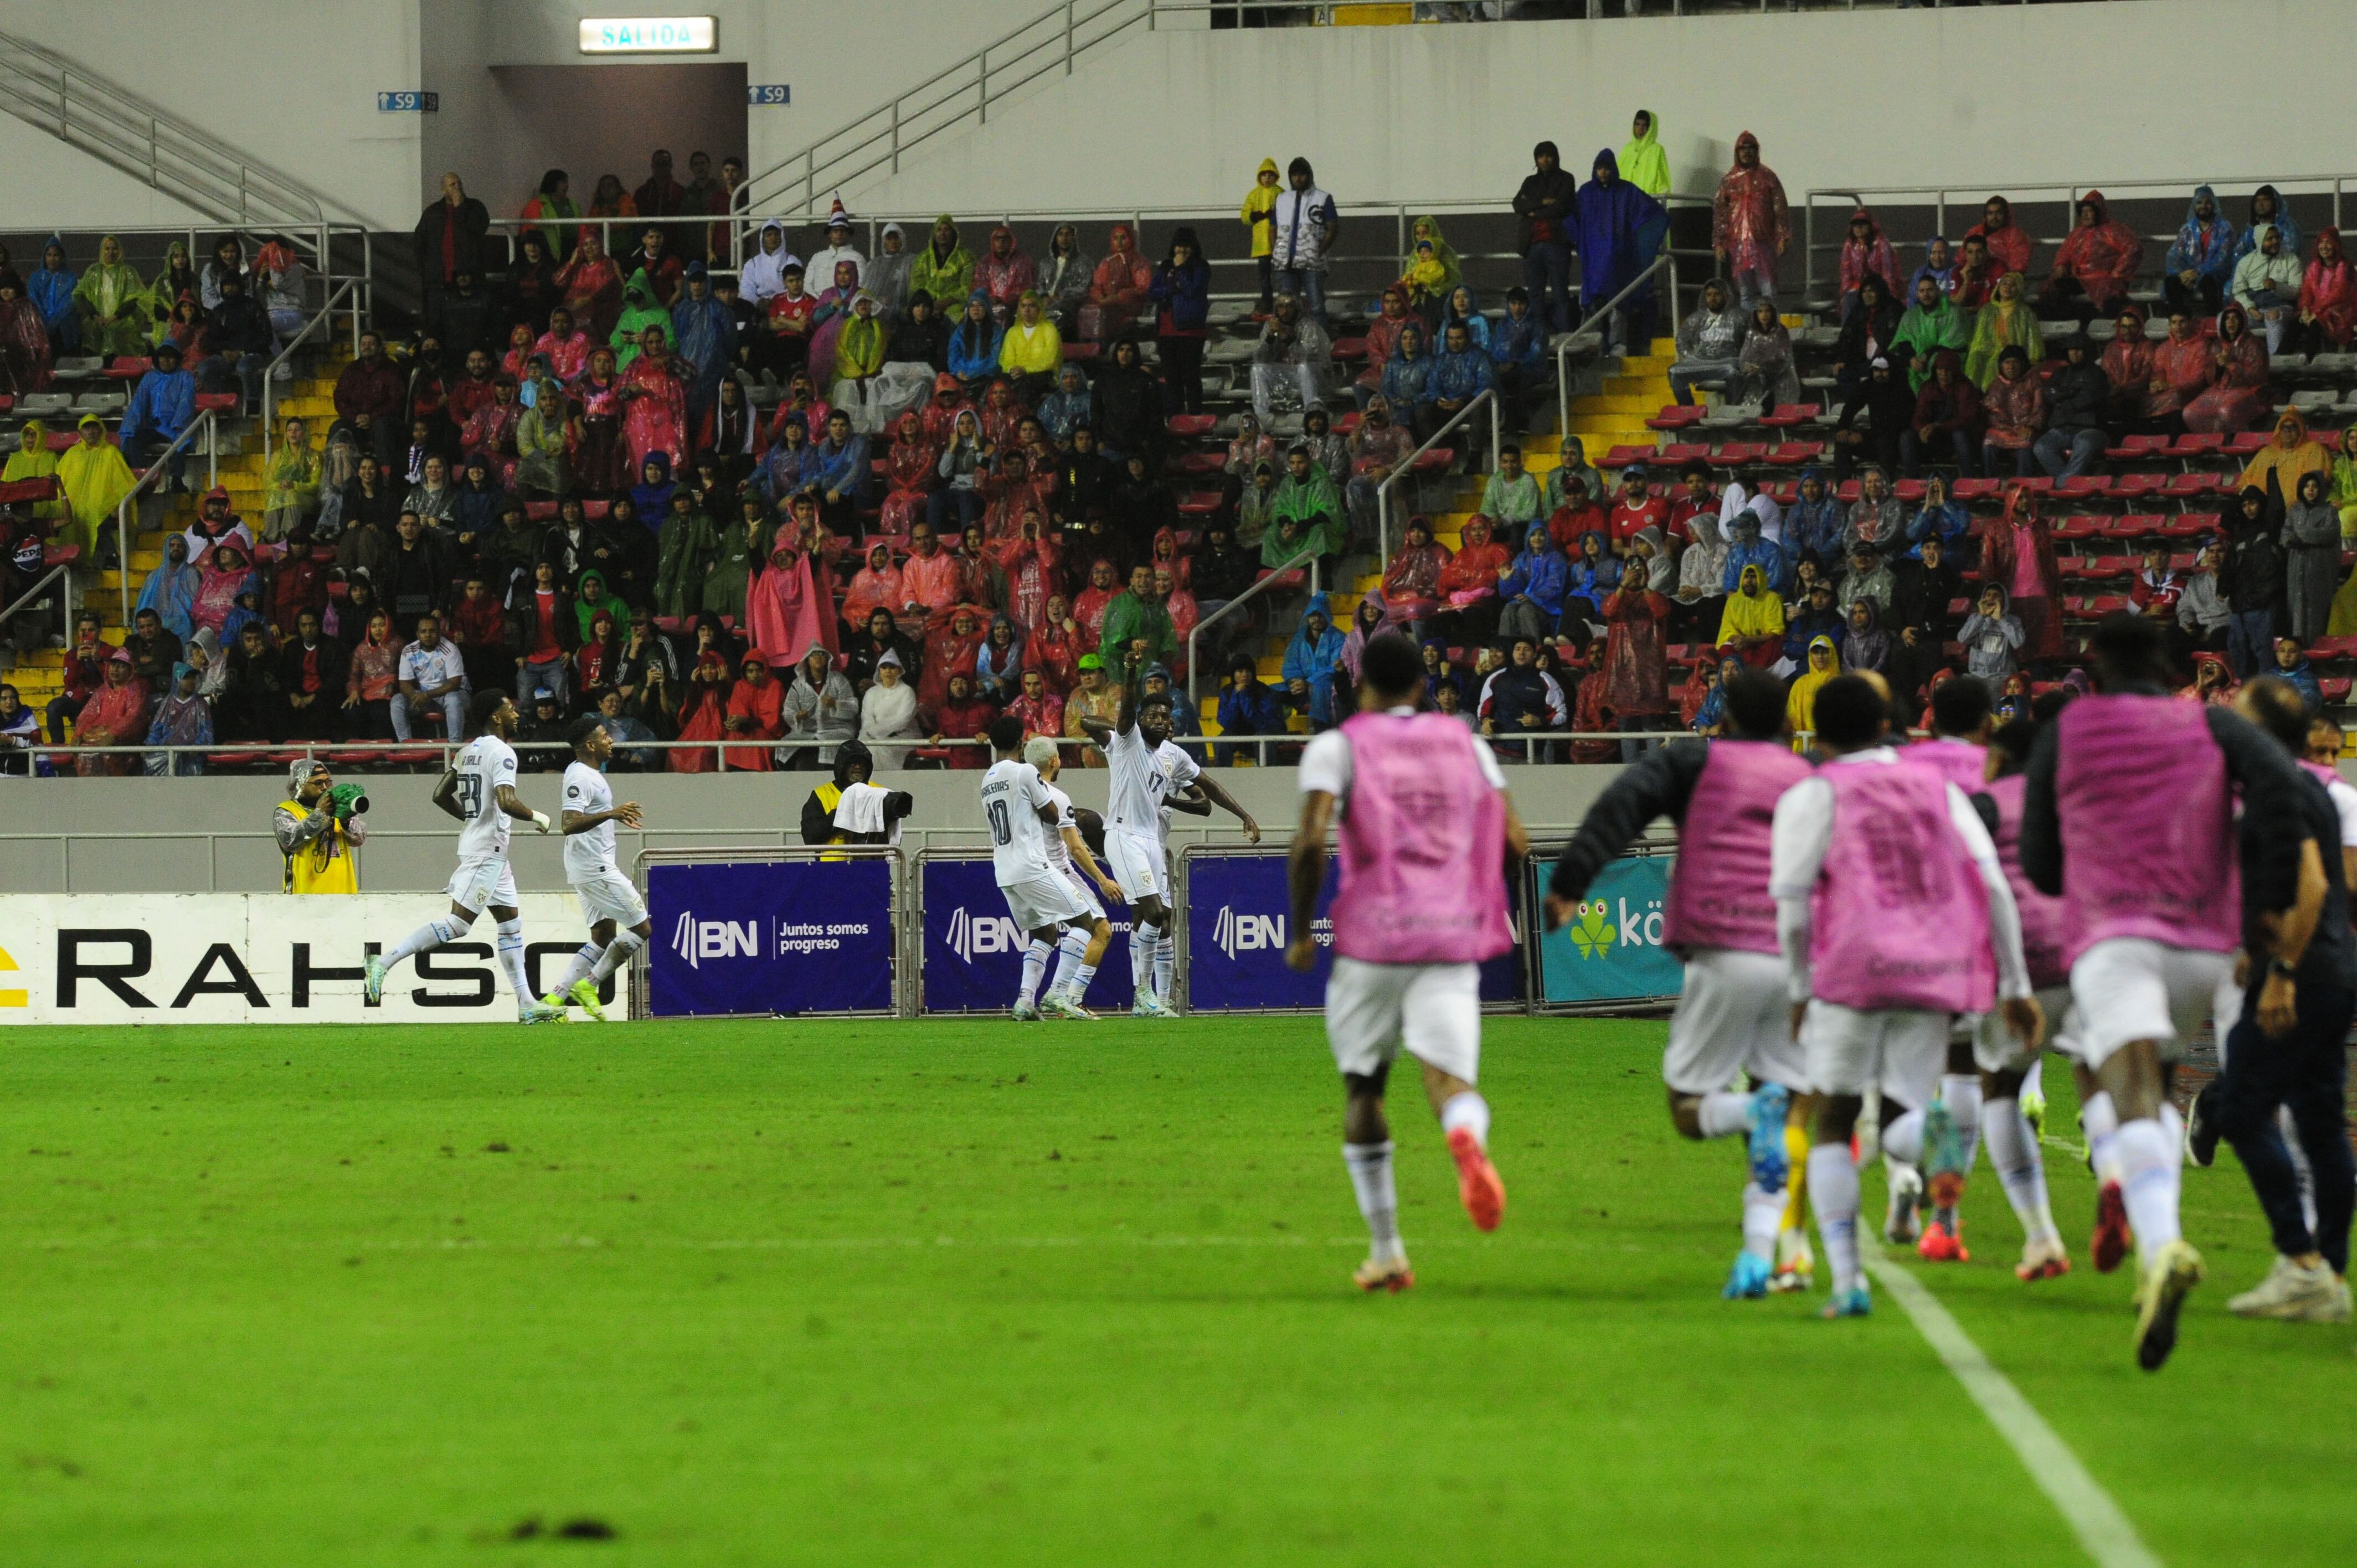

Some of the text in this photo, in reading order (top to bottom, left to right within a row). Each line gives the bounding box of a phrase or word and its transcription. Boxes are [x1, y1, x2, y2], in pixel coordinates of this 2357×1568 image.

[601, 24, 691, 46] SALIDA
[395, 93, 415, 109] S9
[765, 86, 785, 102] S9
[1148, 770, 1164, 793] 17
[456, 773, 482, 818] 23
[987, 799, 1012, 847] 10
[780, 922, 868, 936] Juntos somos
[1236, 915, 1285, 950] BN
[1309, 917, 1333, 929] unto
[699, 920, 758, 958] BN
[780, 937, 840, 955] progreso
[972, 917, 1030, 953] BN
[56, 929, 616, 1008] RAHSO
